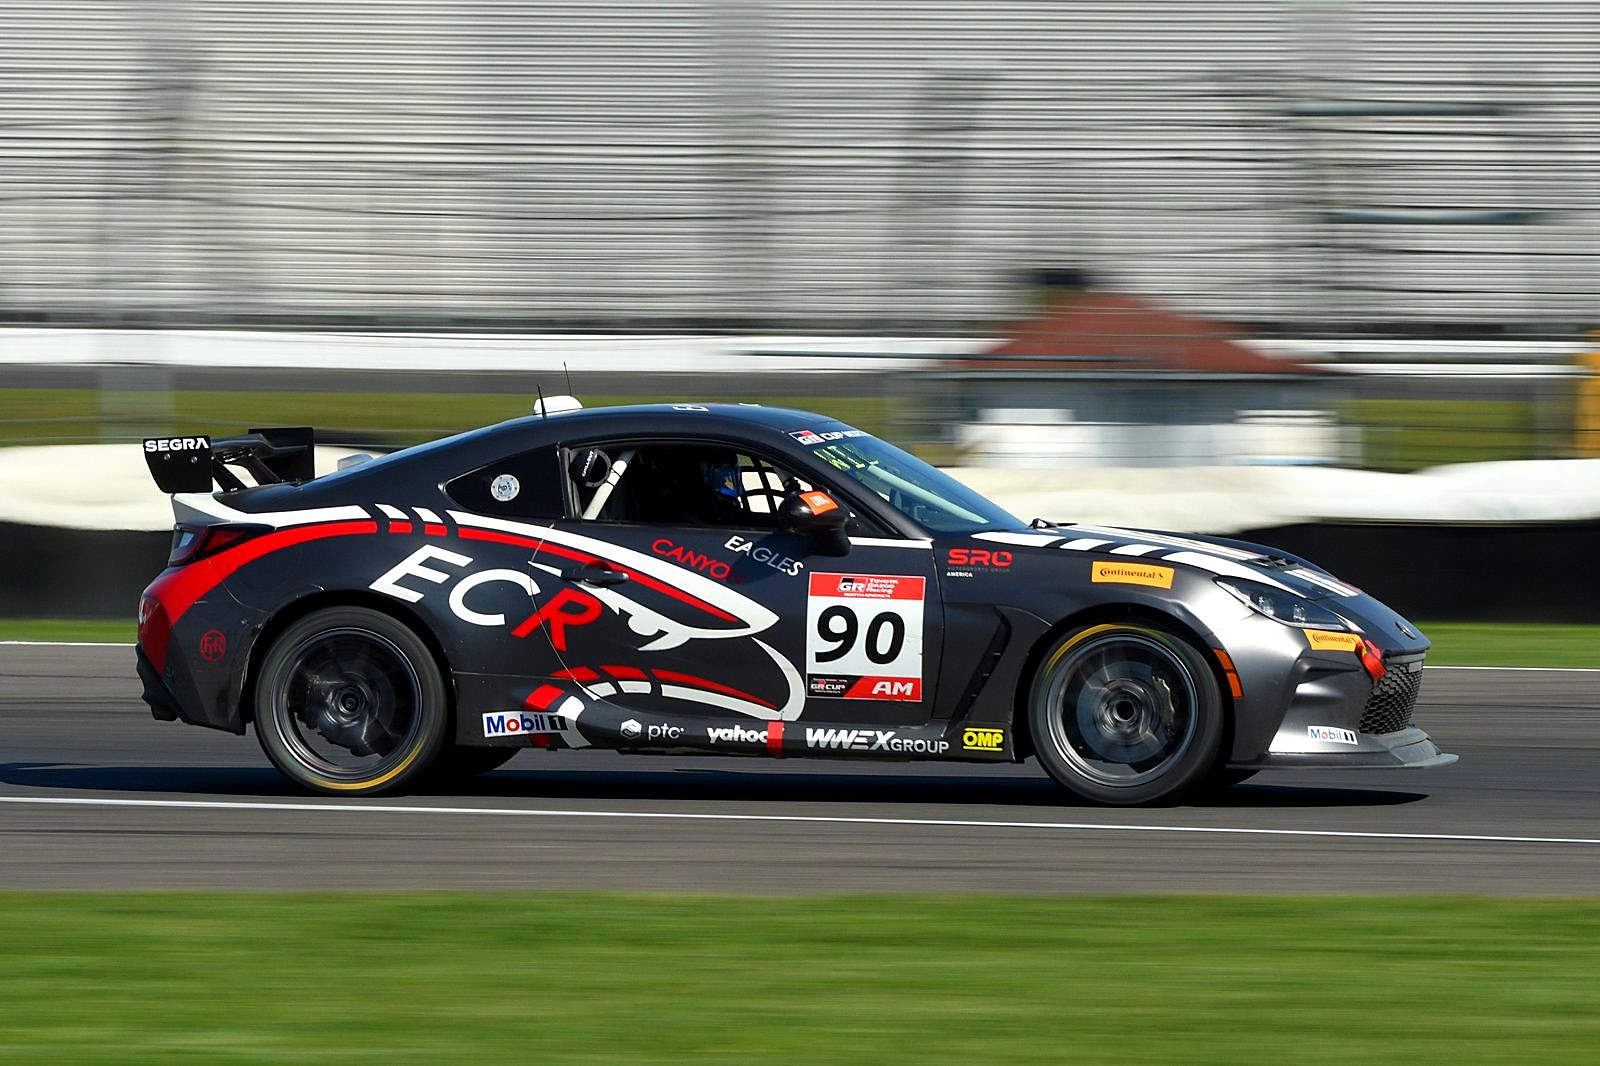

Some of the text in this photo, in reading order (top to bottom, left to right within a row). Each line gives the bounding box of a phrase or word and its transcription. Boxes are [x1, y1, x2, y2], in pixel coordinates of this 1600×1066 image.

[144, 437, 210, 453] SEGRA
[724, 535, 804, 577] EAGLES
[947, 548, 1013, 567] SRO
[1100, 568, 1156, 579] Continental
[839, 581, 866, 593] GR
[369, 544, 603, 651] ECR
[815, 605, 905, 665] 90
[872, 681, 914, 696] AM
[486, 713, 546, 734] Mobil
[648, 723, 681, 741] ptc
[962, 730, 1004, 748] OMP
[1310, 728, 1343, 741] Mobil
